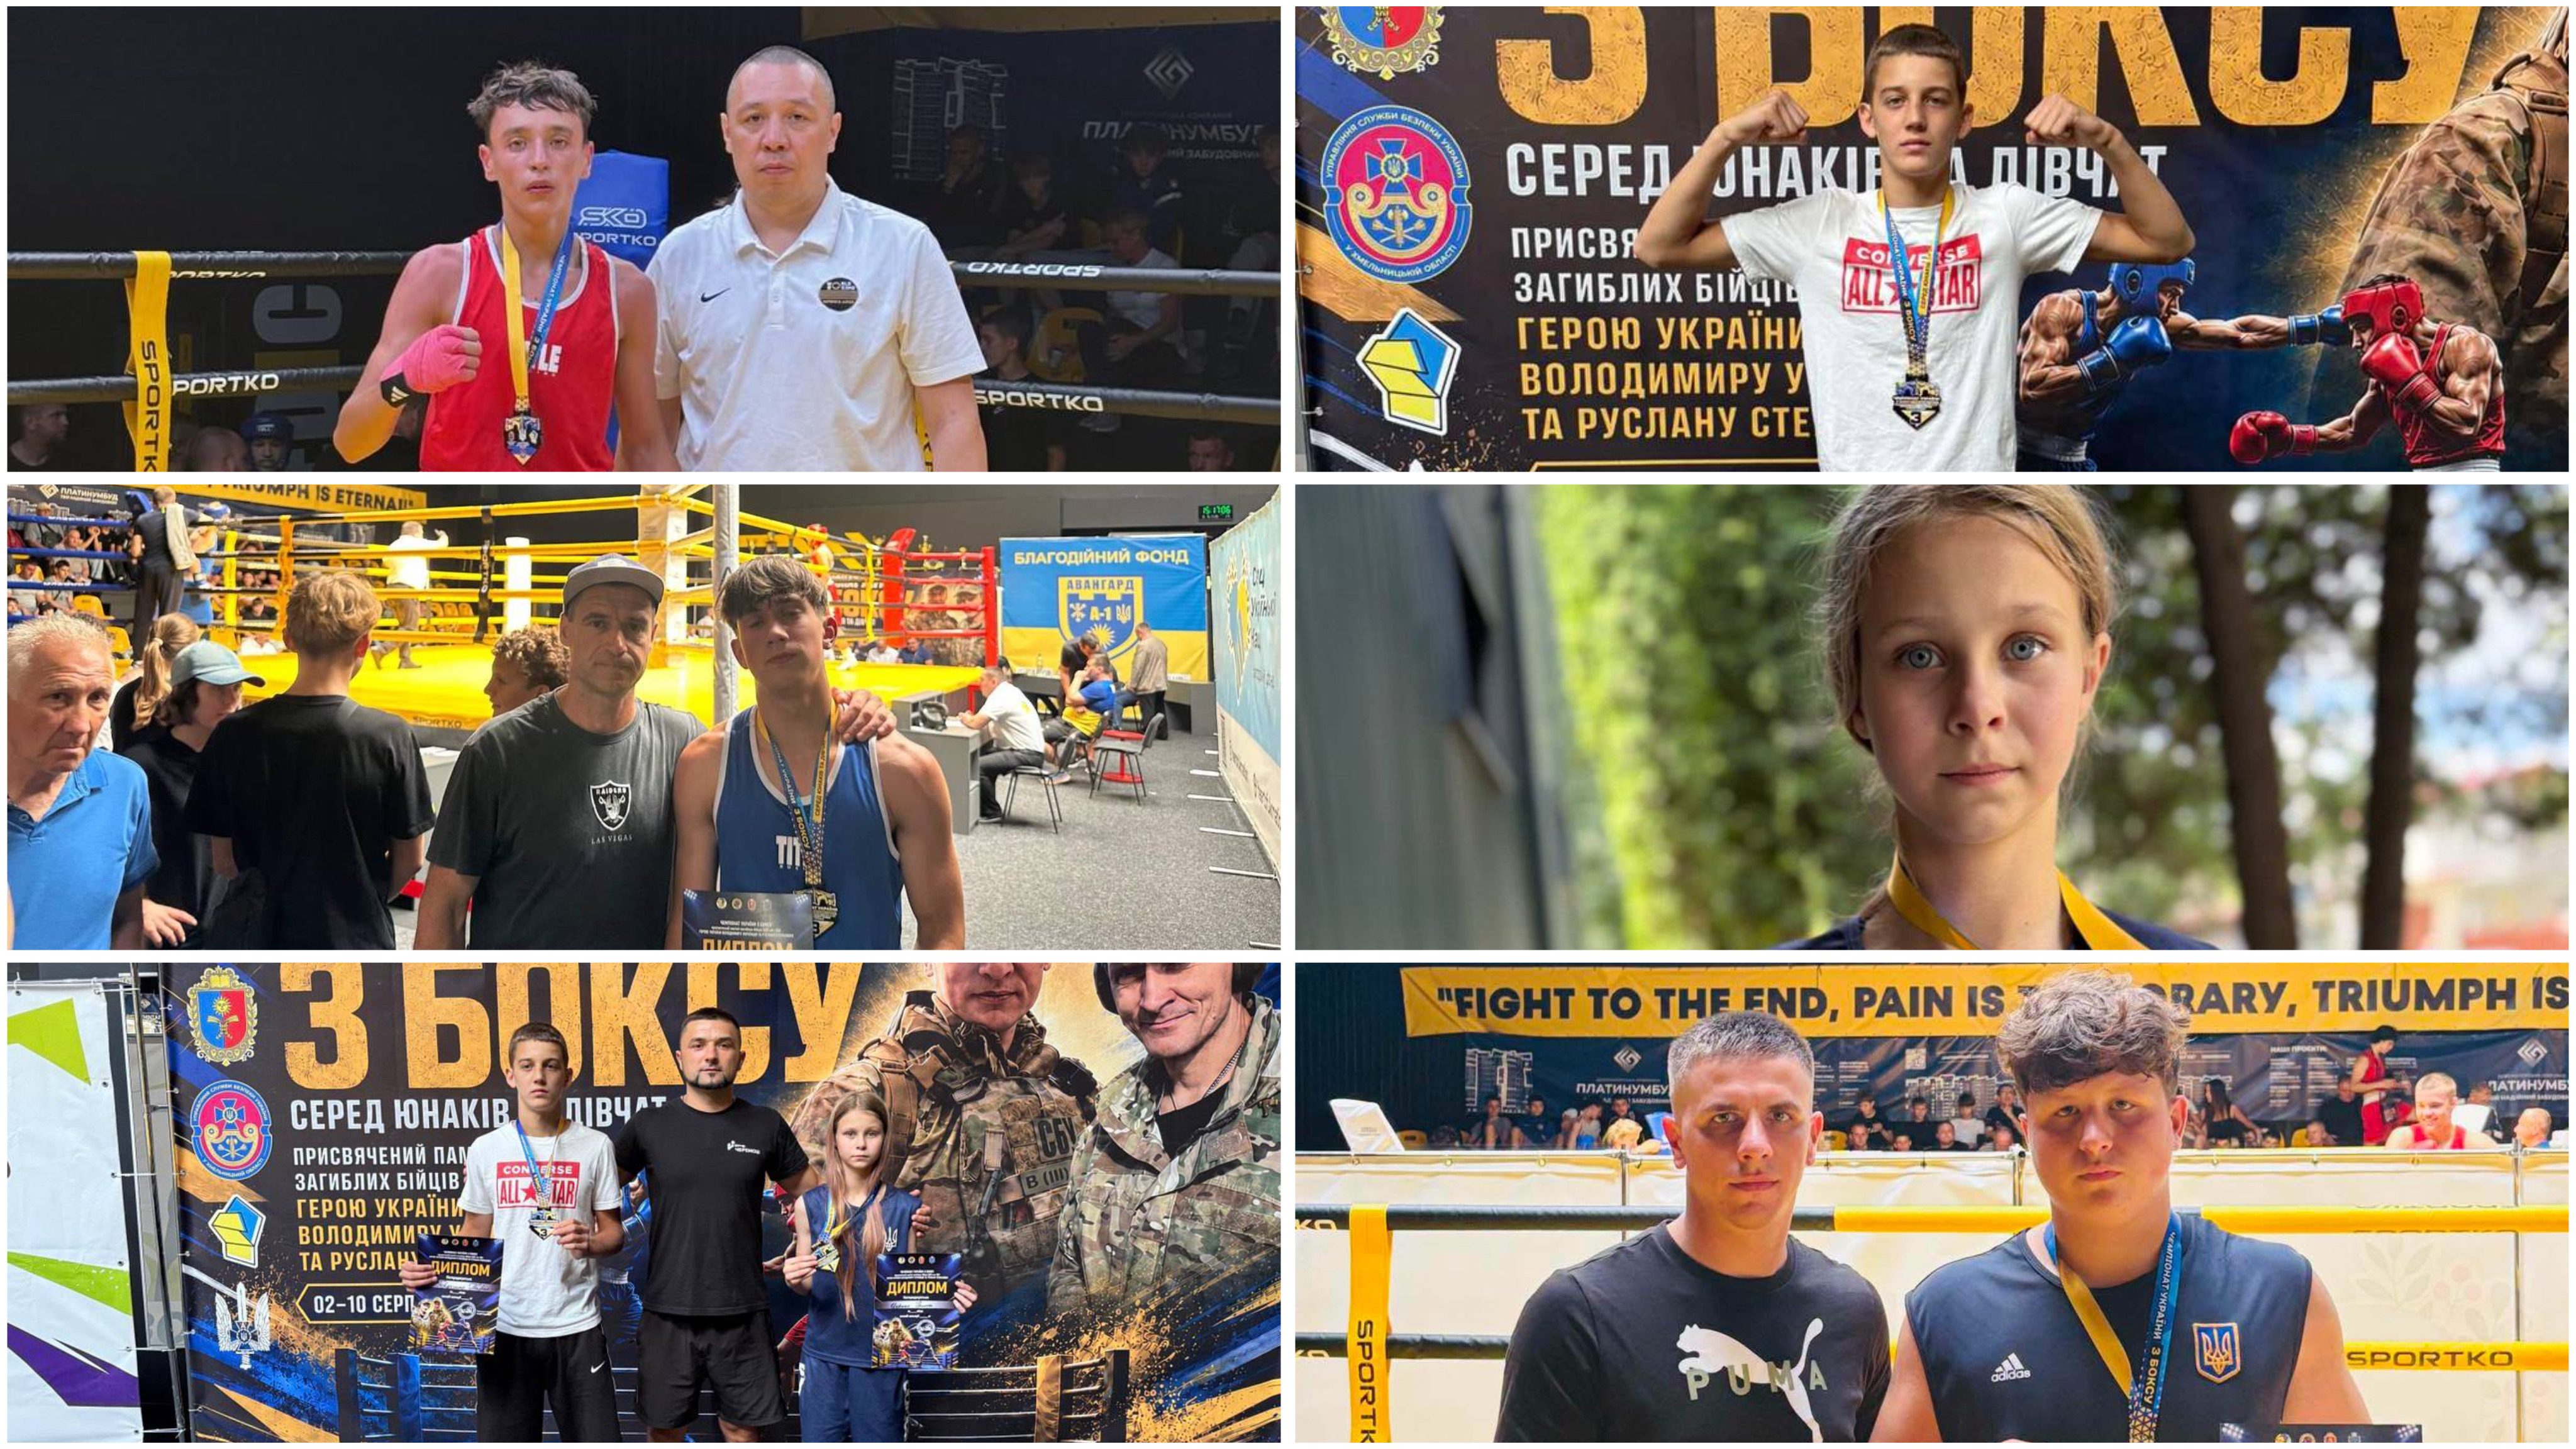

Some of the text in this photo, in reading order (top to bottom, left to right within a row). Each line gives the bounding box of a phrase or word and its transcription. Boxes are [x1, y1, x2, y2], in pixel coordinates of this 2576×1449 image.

[1326, 112, 1464, 179] УПРАВЛІННЯ СЛУЖБИ БЕЗПЕКИ УКРАЇНИ
[1506, 142, 1675, 205] СЕРЕД
[1424, 243, 1458, 273] ОБЛАСТІ
[1511, 227, 1639, 259] ПРИСВЯ
[967, 261, 1104, 277] SPORTKO
[1514, 272, 1683, 303] ЗАГИБЛИХ
[1847, 264, 1975, 306] ALL TAR
[1517, 317, 1641, 350] ГЕРОЮ
[172, 374, 280, 396] PORTKO
[1520, 362, 1769, 399] ВОЛОДИМИРУ
[141, 340, 160, 472] SPORTK
[1521, 406, 1811, 440] ТА РУСЛАНУ СТЕ
[1014, 548, 1189, 565] БЛАГОДІЙНИЙ ФОНД
[1067, 579, 1135, 591] АВАНГАРД
[1089, 606, 1112, 621] А-1
[796, 817, 811, 850] БОКСУ
[775, 835, 801, 867] TIT
[1438, 988, 1575, 1019] "FIGHT
[1587, 987, 1642, 1019] TO
[1654, 988, 1729, 1019] THE
[1744, 987, 1839, 1022] END,
[1854, 985, 1953, 1018] PAIN
[1967, 985, 2005, 1017] IS
[2312, 977, 2516, 1013] TRIUMPH
[2532, 977, 2569, 1009] IS
[280, 962, 865, 1090] З БОКСУ
[1576, 1083, 1668, 1095] ПЛАТИНУМБУ
[2488, 1079, 2569, 1092] ЛАТИНУМБ
[291, 1099, 386, 1134] СЕРЕД
[394, 1097, 509, 1130] ЮНАКІВ
[293, 1143, 426, 1165] ПРИСВЯЧЕНИЙ
[295, 1169, 460, 1192] ЗАГИБЛИХ БІЙЦІВ
[504, 1165, 573, 1175] CONERSE
[297, 1194, 464, 1218] ГЕРОЮ УКРАЇНИ
[500, 1179, 575, 1204] ALL TAR
[540, 1229, 548, 1237] 3
[299, 1252, 323, 1271] ТА
[431, 1260, 491, 1277] ДИПЛОМ
[2162, 1231, 2176, 1290] ЧЕМПІОНАТ
[372, 1294, 415, 1313] СЕРП
[887, 1281, 948, 1296] ДИПЛОМ
[2153, 1289, 2168, 1340] УКРАЇНИ
[2347, 1351, 2513, 1367] SPORTKO
[1357, 1319, 1376, 1443] SPORTK
[1685, 1360, 1828, 1401] PUMA
[1991, 1368, 2031, 1383] adidas
[2143, 1358, 2159, 1404] БОКСУ
